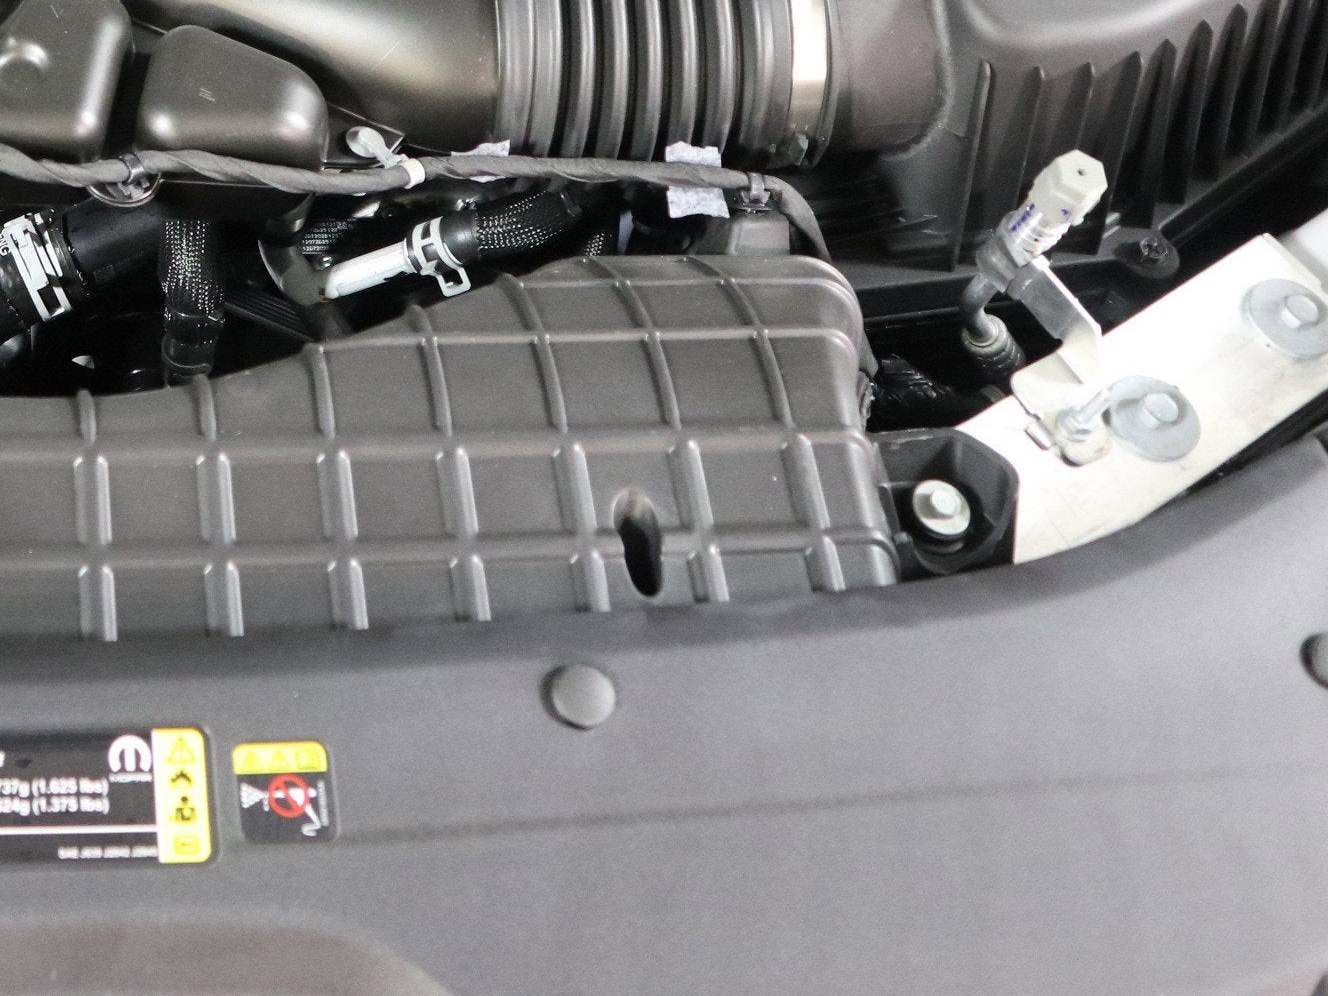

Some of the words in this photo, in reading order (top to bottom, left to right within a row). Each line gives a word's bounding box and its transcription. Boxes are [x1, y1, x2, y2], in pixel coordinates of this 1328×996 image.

[31, 777, 78, 797] (1.625
[79, 776, 110, 797] lbs)
[31, 795, 79, 816] (1.375
[79, 795, 110, 815] lbs)
